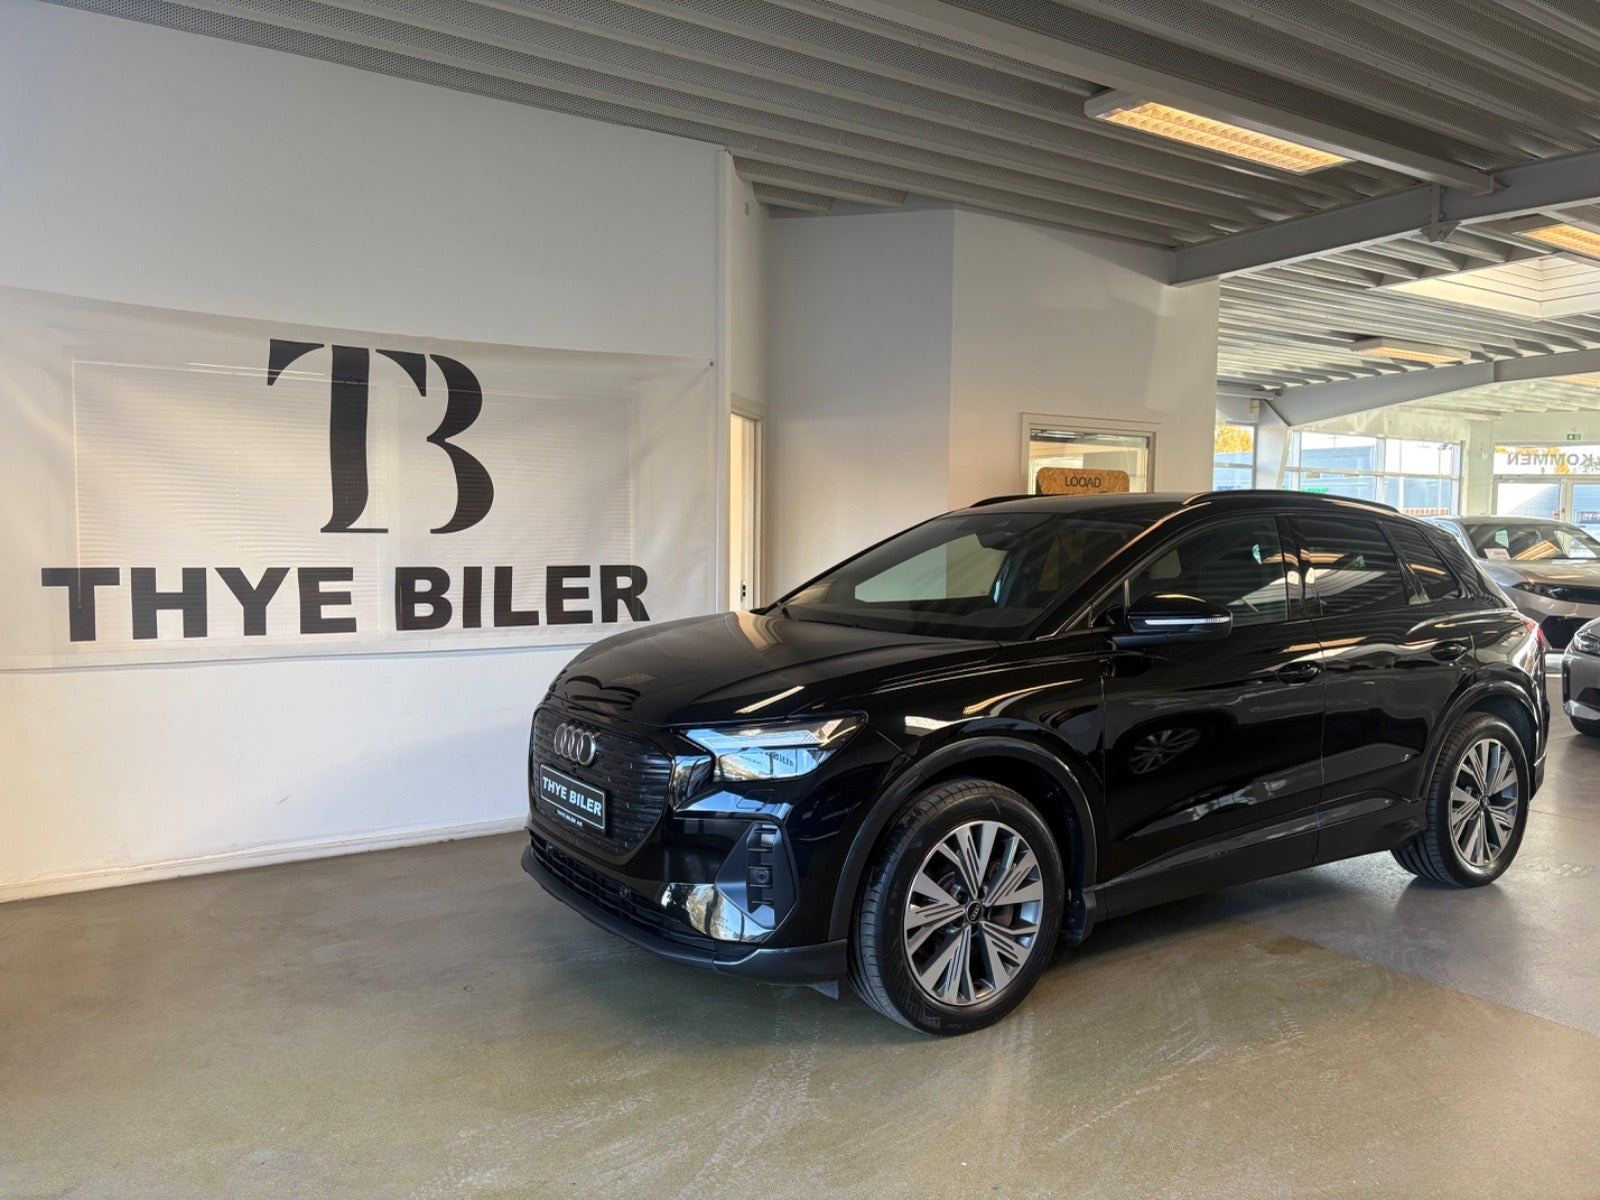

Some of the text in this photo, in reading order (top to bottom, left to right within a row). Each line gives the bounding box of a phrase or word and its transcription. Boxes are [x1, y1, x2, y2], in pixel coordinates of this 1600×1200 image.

[41, 564, 650, 641] THYE BILER
[543, 776, 602, 817] THYE BILER
